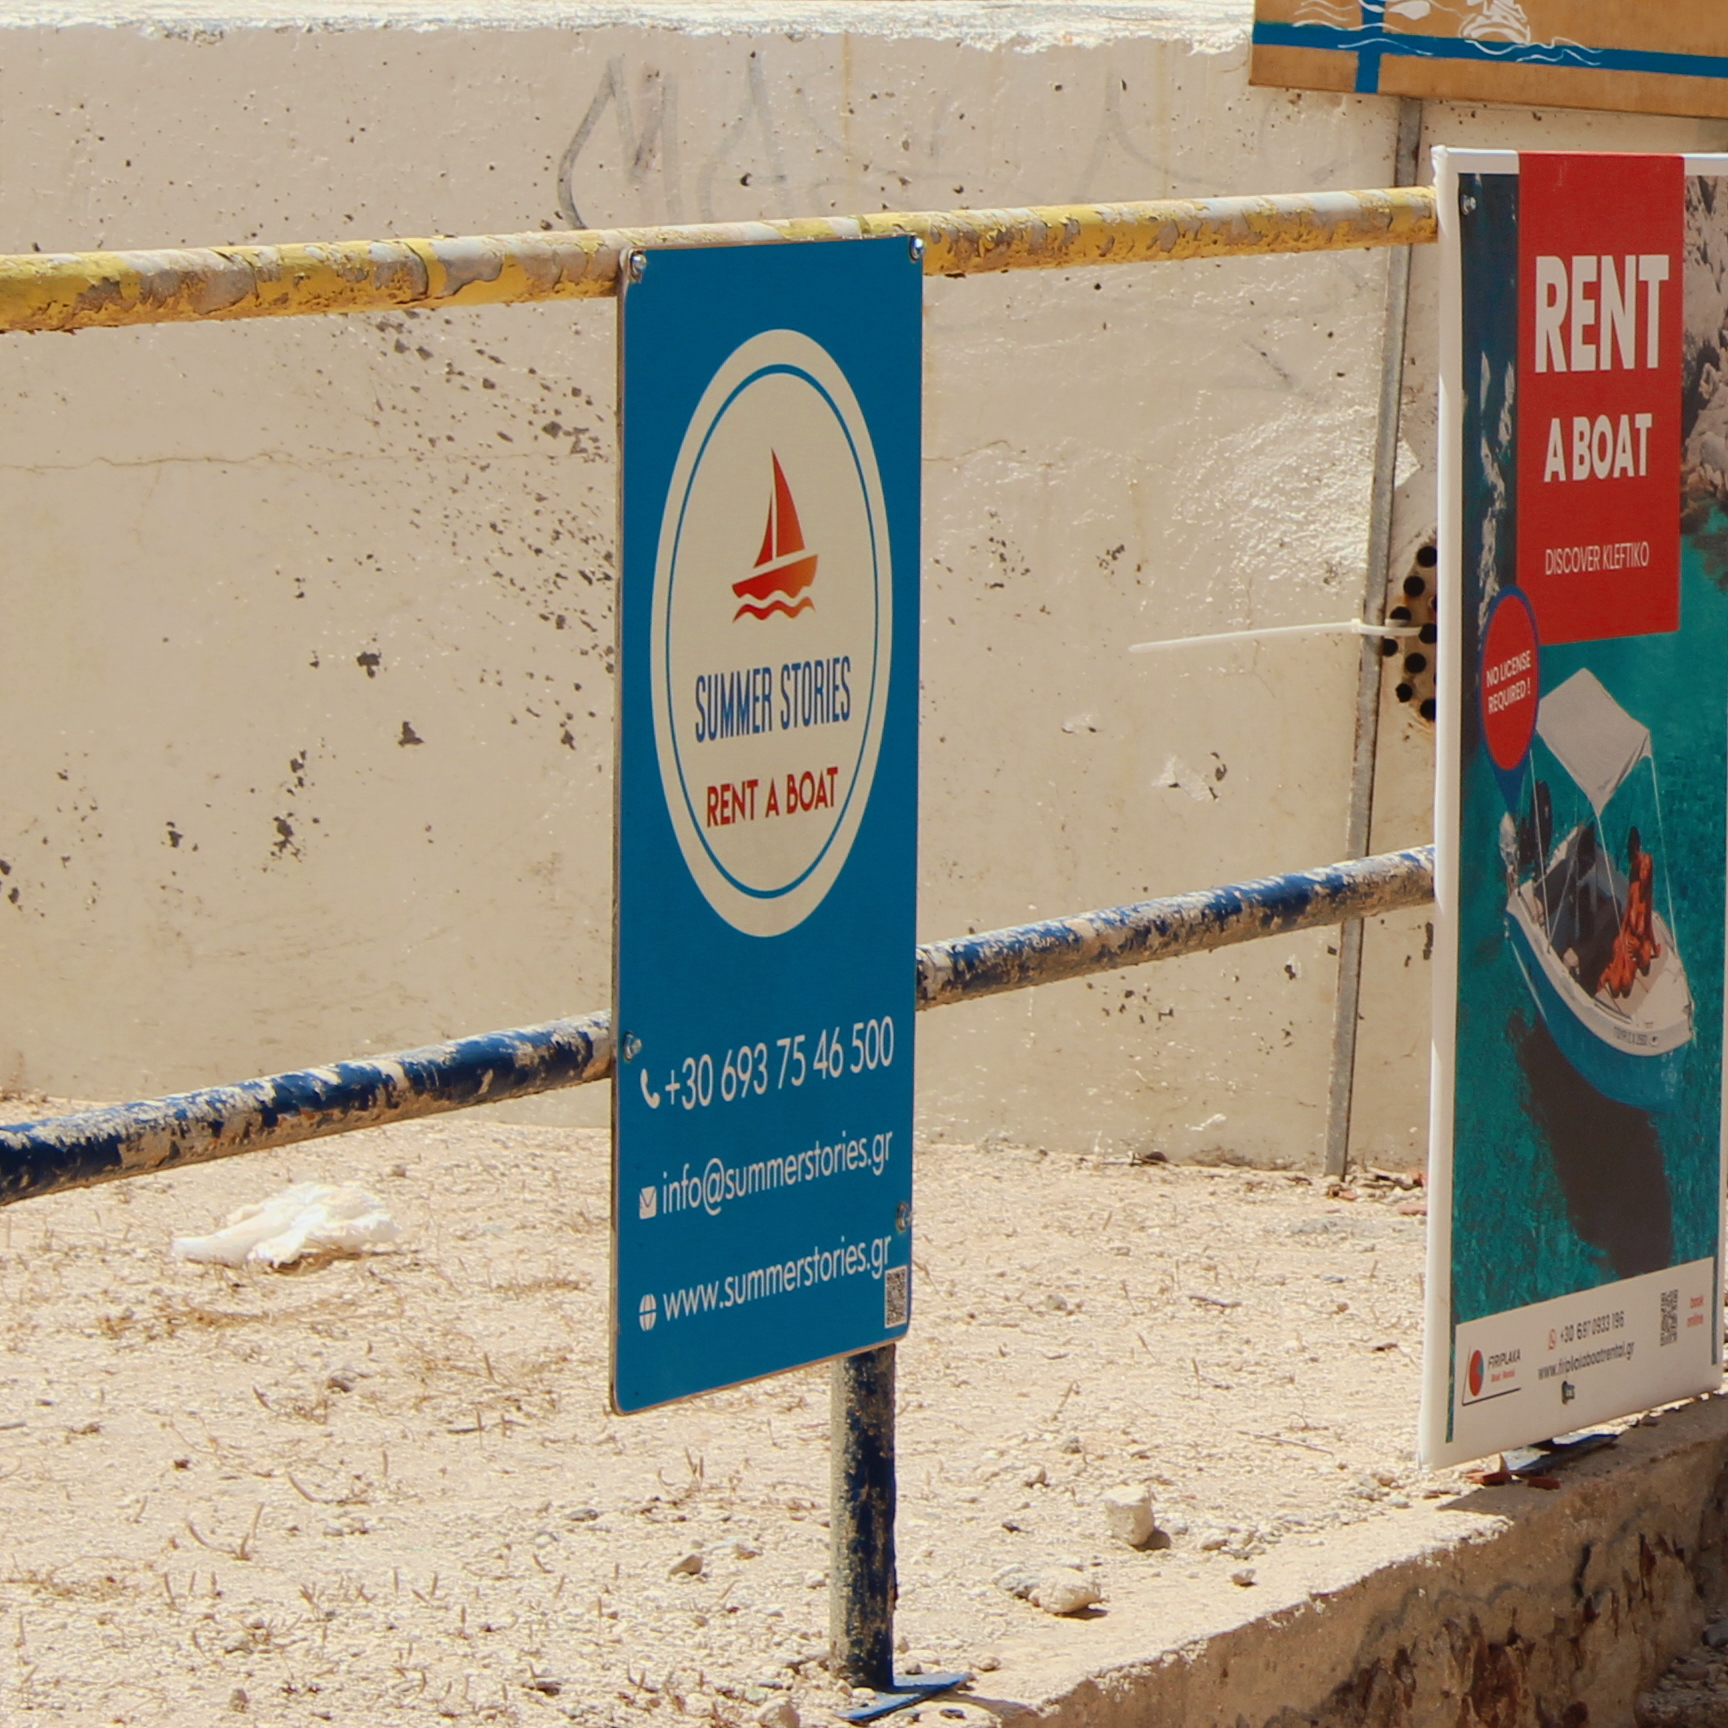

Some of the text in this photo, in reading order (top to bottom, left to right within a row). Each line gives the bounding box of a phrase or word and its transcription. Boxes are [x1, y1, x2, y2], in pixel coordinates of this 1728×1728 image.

[1534, 252, 1670, 373] RENT
[1544, 412, 1653, 483] A BOAT
[1545, 541, 1650, 576] DISCOVER KLEFTIKO
[695, 655, 851, 743] SUMMER STORIES
[1486, 649, 1531, 688] NO LICENSE
[706, 766, 839, 828] RENT A BOAT
[665, 1016, 894, 1110] +30 693 75 46 500
[662, 1130, 893, 1216] info@summerstories.gr
[662, 1235, 892, 1321] www.summerstories.gr
